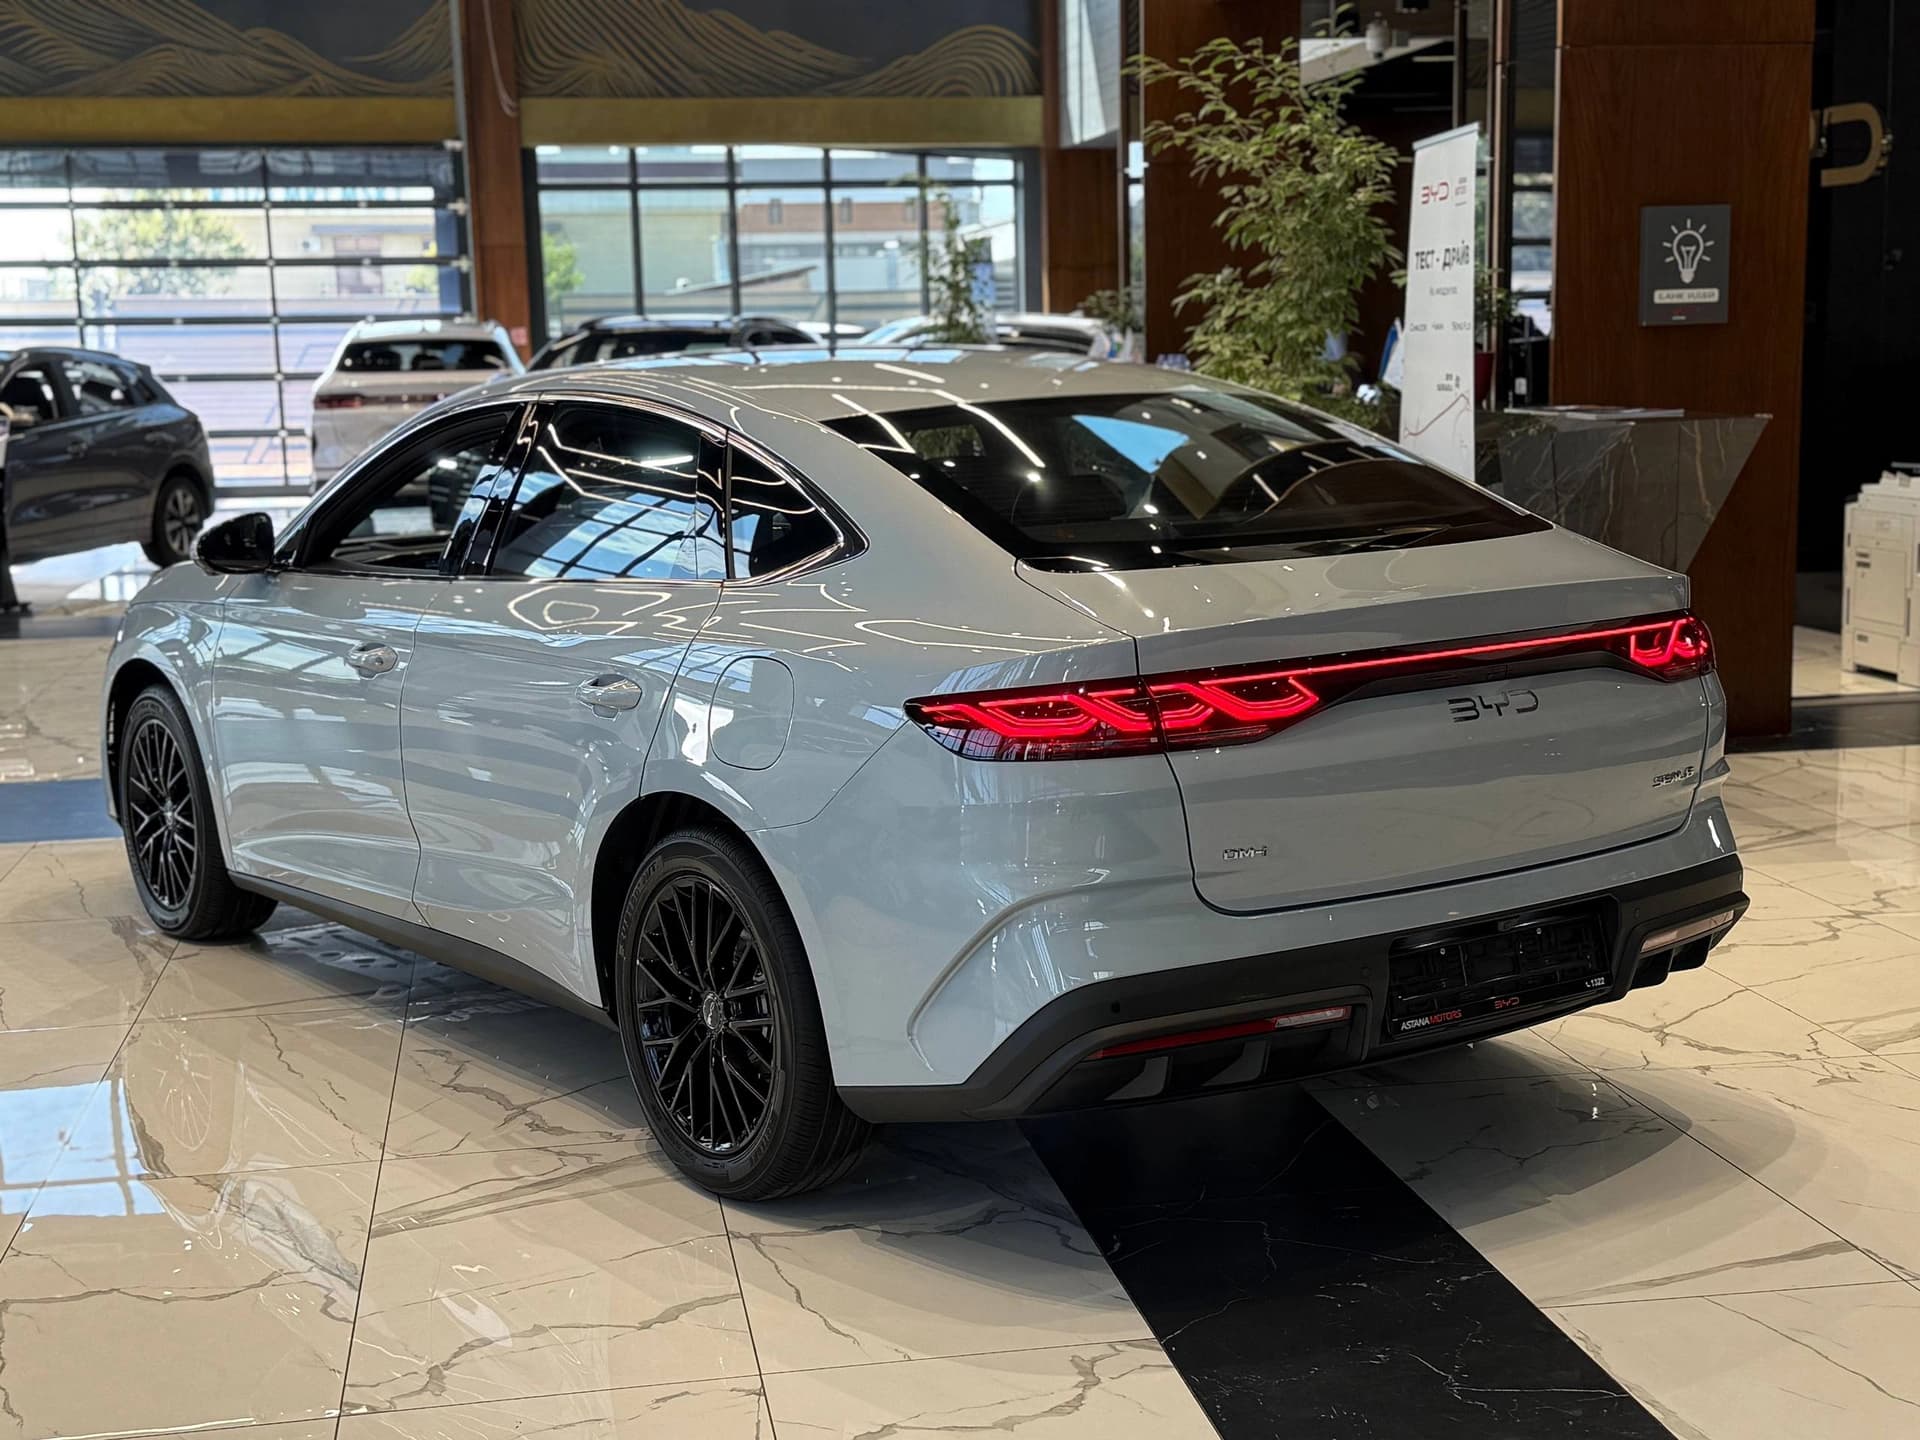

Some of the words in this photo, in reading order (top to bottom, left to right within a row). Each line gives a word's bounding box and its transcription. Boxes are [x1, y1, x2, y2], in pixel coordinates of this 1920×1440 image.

[1421, 182, 1449, 205] BYD
[1447, 689, 1539, 723] BYD
[1400, 1016, 1430, 1031] ASTANA
[1429, 1009, 1462, 1024] MOTORS
[1495, 996, 1520, 1009] BYD
